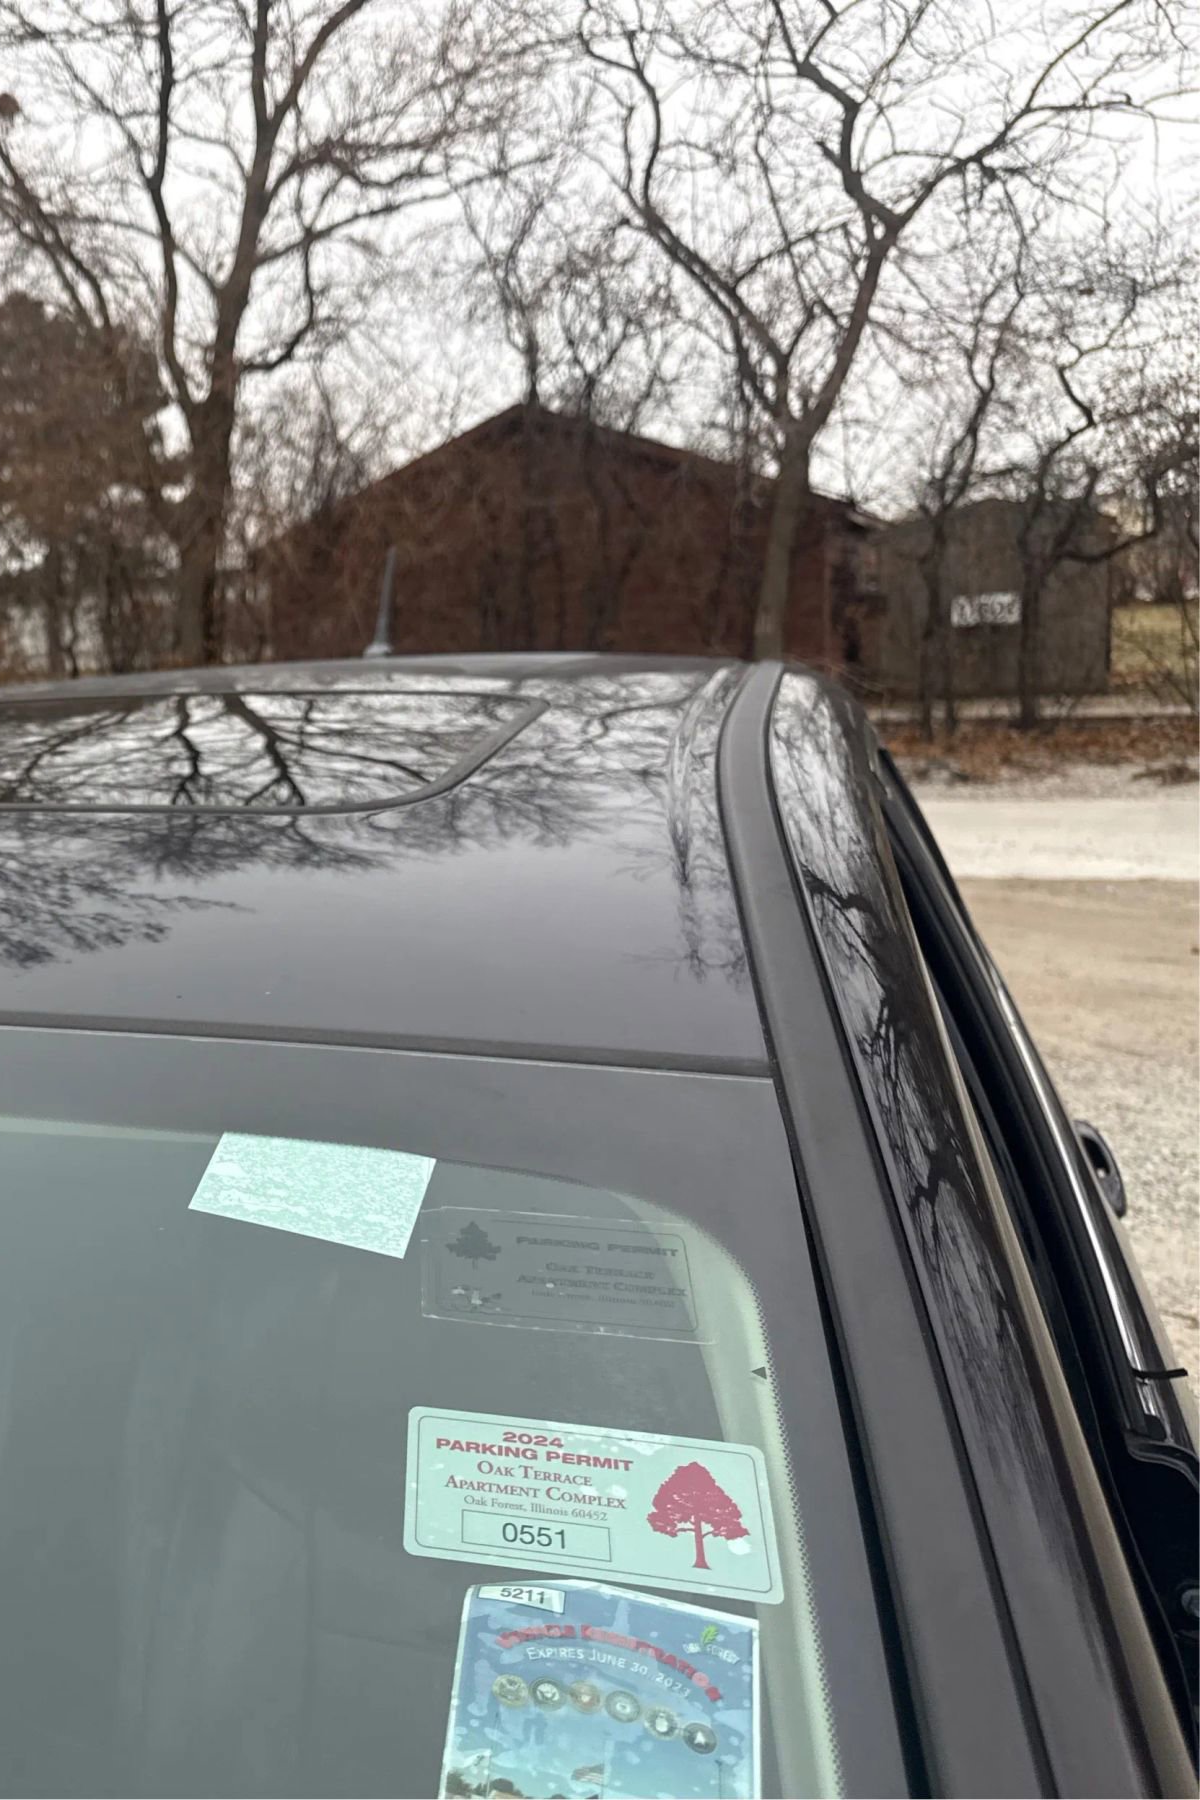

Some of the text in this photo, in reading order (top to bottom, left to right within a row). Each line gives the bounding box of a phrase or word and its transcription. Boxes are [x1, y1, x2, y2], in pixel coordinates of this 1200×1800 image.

[502, 1431, 564, 1448] 2024
[436, 1437, 634, 1471] PARKING PERMIT
[477, 1460, 593, 1487] OAK TERRACE
[444, 1474, 627, 1510] APARTMENT COMPLEX
[464, 1494, 608, 1522] Oak Forest, Illinois 60452
[502, 1522, 566, 1549] 0551
[500, 1586, 546, 1605] 5211
[526, 1646, 585, 1660] EXPIRES
[589, 1647, 626, 1668] JUNE
